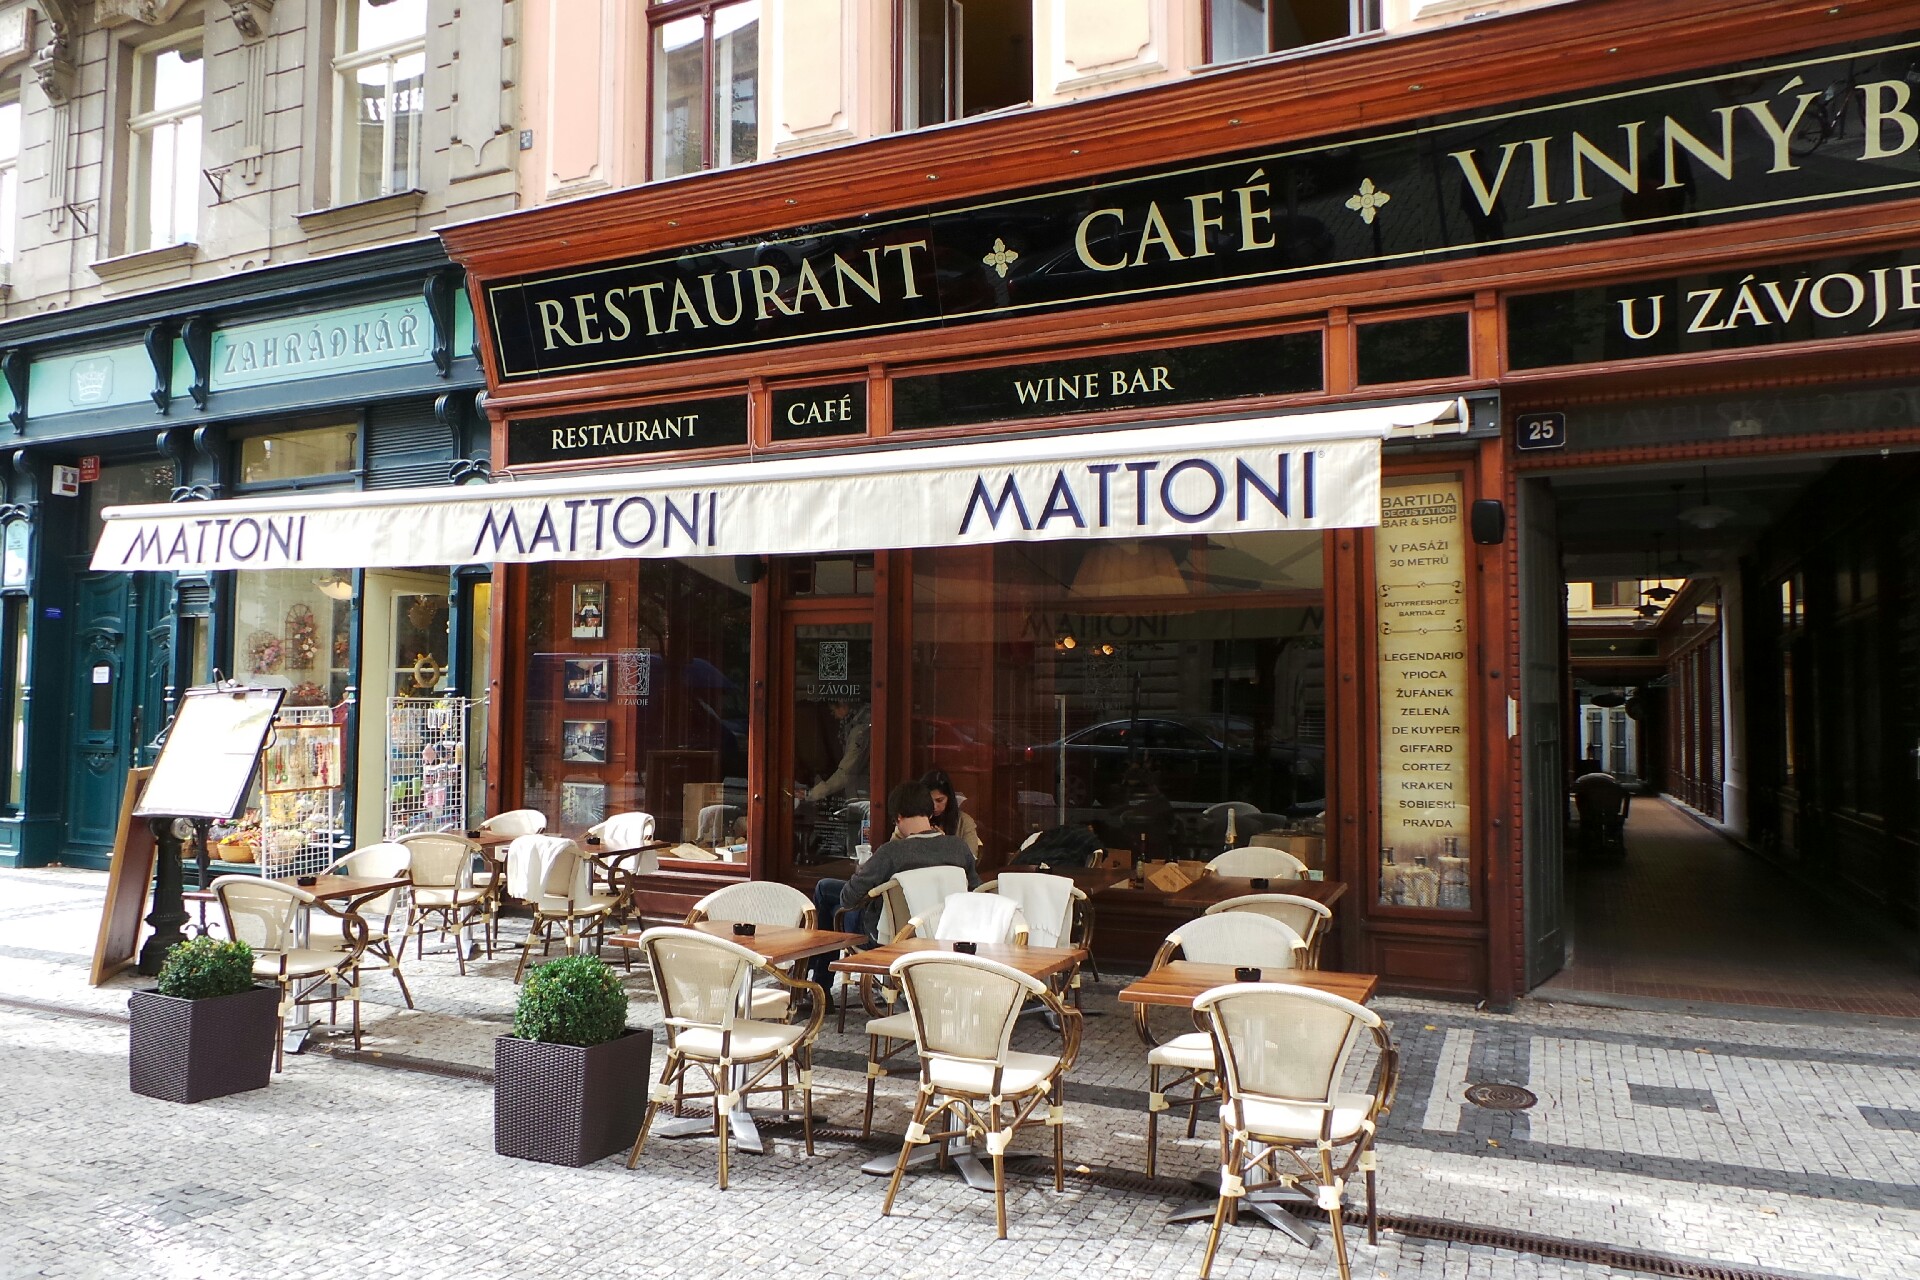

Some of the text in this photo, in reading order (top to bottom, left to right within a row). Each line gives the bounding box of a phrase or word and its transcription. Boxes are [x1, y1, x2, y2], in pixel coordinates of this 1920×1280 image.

[1447, 75, 1920, 216] VINNÝ B
[1075, 168, 1277, 271] CAFÉ
[535, 240, 927, 350] RESTAURANT
[1618, 295, 1664, 340] U
[223, 308, 420, 375] ZAHRÁDKÁŘ
[1014, 366, 1175, 404] WINE BAR
[787, 394, 852, 425] CAFÉ
[551, 415, 699, 449] RESTAURANT
[1529, 420, 1554, 440] 25
[1381, 492, 1457, 508] BARTIDA
[1383, 506, 1456, 518] DEGUSTATION
[473, 491, 718, 556] MATTONI
[1382, 515, 1457, 528] BAR & SHOP
[122, 515, 305, 565] MATTONI
[1389, 540, 1449, 553] V PASÁŽI
[1389, 554, 1449, 567] 30 METRŮ
[1384, 651, 1464, 661] LEGENDARIO
[1401, 670, 1447, 679] YPIOCA
[807, 681, 861, 696] U ZÁVOJE
[1396, 687, 1454, 698] ŽUFÁNEK
[1401, 705, 1450, 716] ZELENÁ
[1391, 726, 1461, 735] DE KUYPER
[1399, 744, 1453, 753] GIFFARD
[1402, 763, 1451, 772] CORTEZ
[1401, 781, 1453, 790] KRAKEN
[1399, 800, 1456, 809] SOBIESKI
[1402, 819, 1453, 828] PRAVDA
